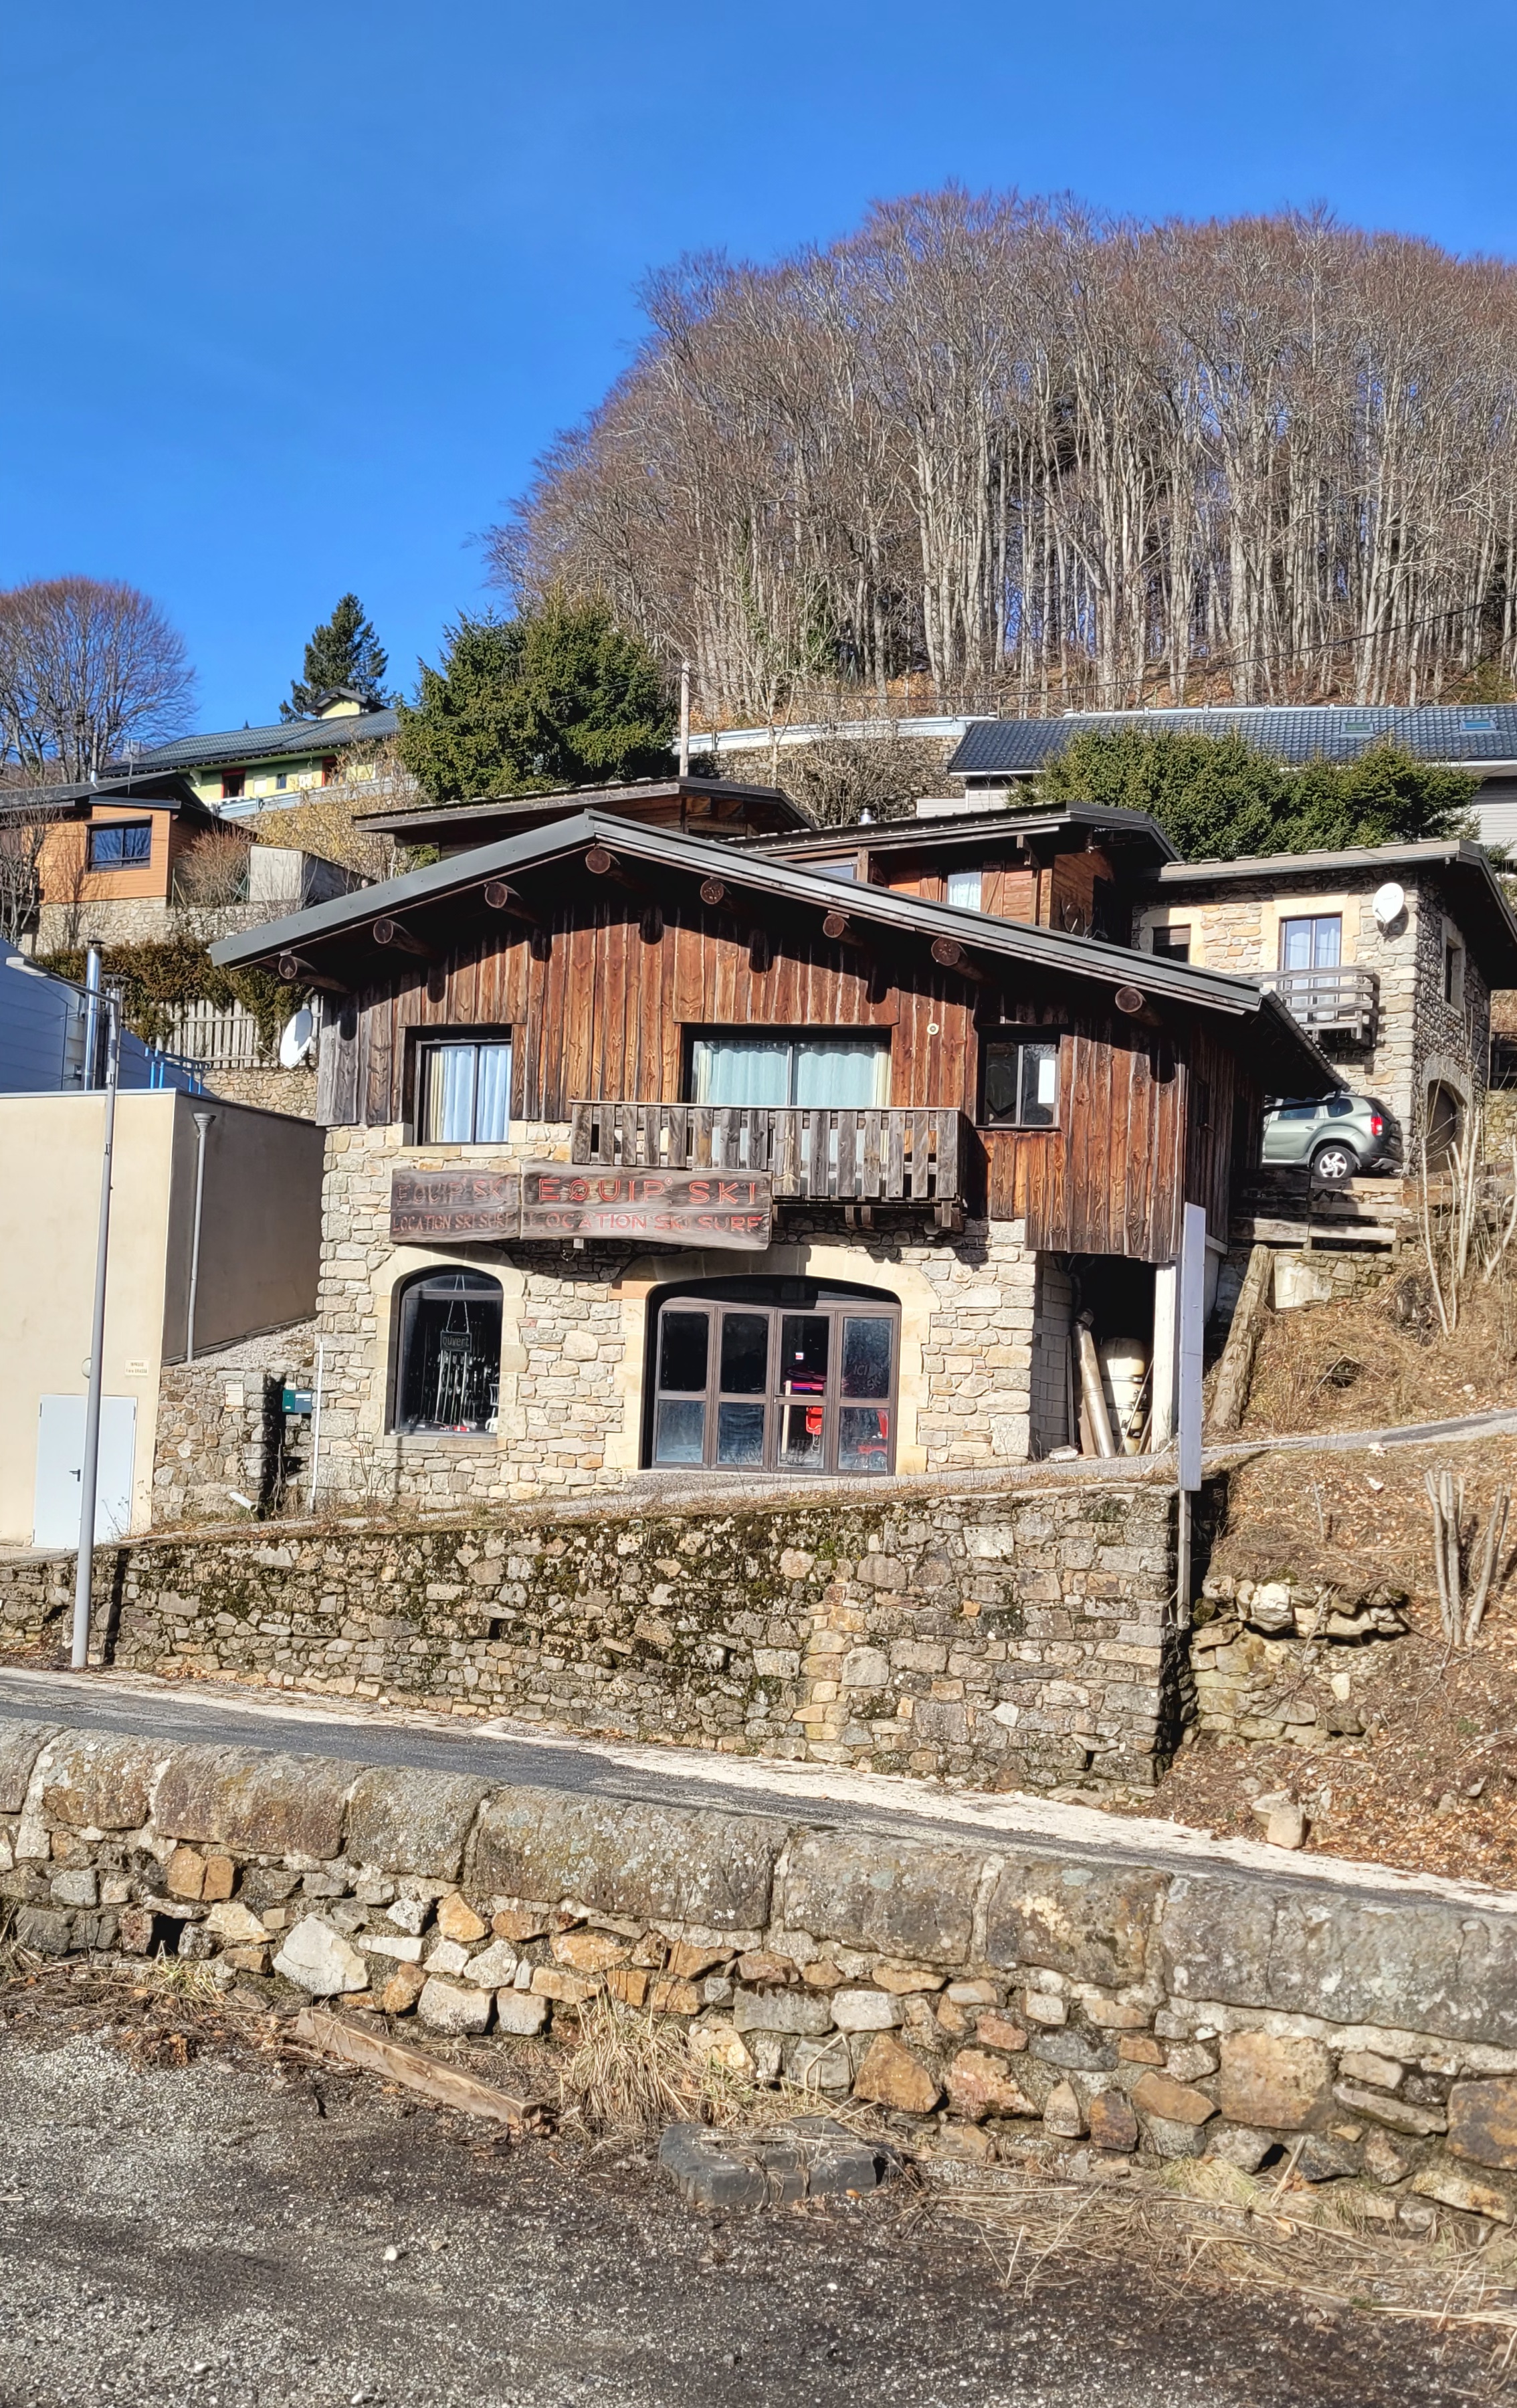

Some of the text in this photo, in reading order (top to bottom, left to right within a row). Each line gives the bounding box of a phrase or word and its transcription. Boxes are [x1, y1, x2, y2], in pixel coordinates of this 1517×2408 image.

[688, 1181, 756, 1205] SKI
[392, 1213, 451, 1231] LOCATION
[455, 1213, 476, 1229] SKI
[529, 1211, 763, 1233] LOCATION SKI SURF
